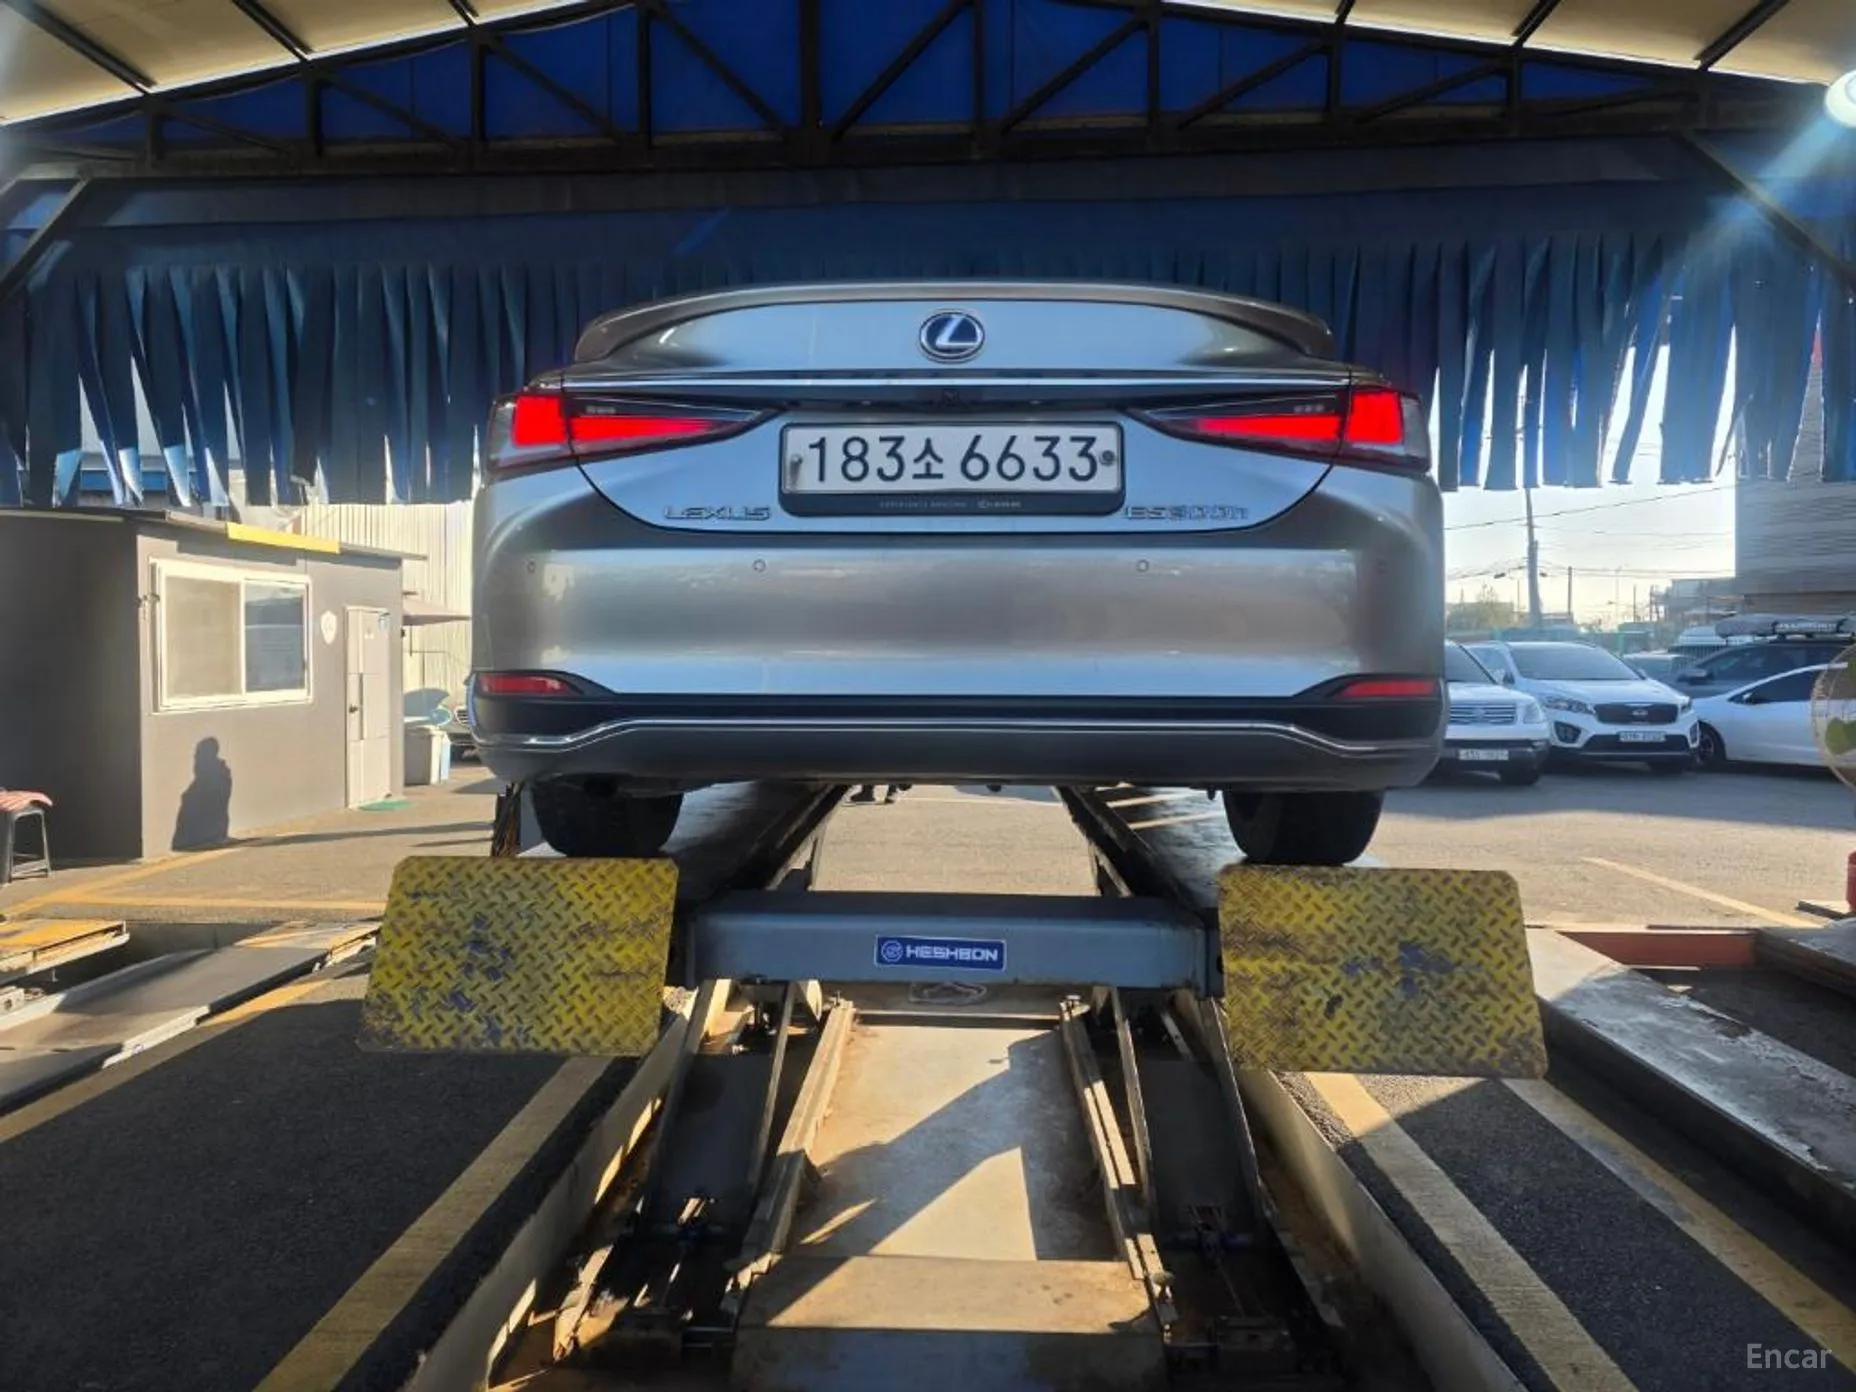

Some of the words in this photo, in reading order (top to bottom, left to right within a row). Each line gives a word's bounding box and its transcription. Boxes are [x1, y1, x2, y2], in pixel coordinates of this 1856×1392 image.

[808, 435, 944, 482] 183소
[960, 434, 1098, 482] 6633
[664, 506, 772, 521] LEXUS
[906, 944, 998, 962] HESHBON
